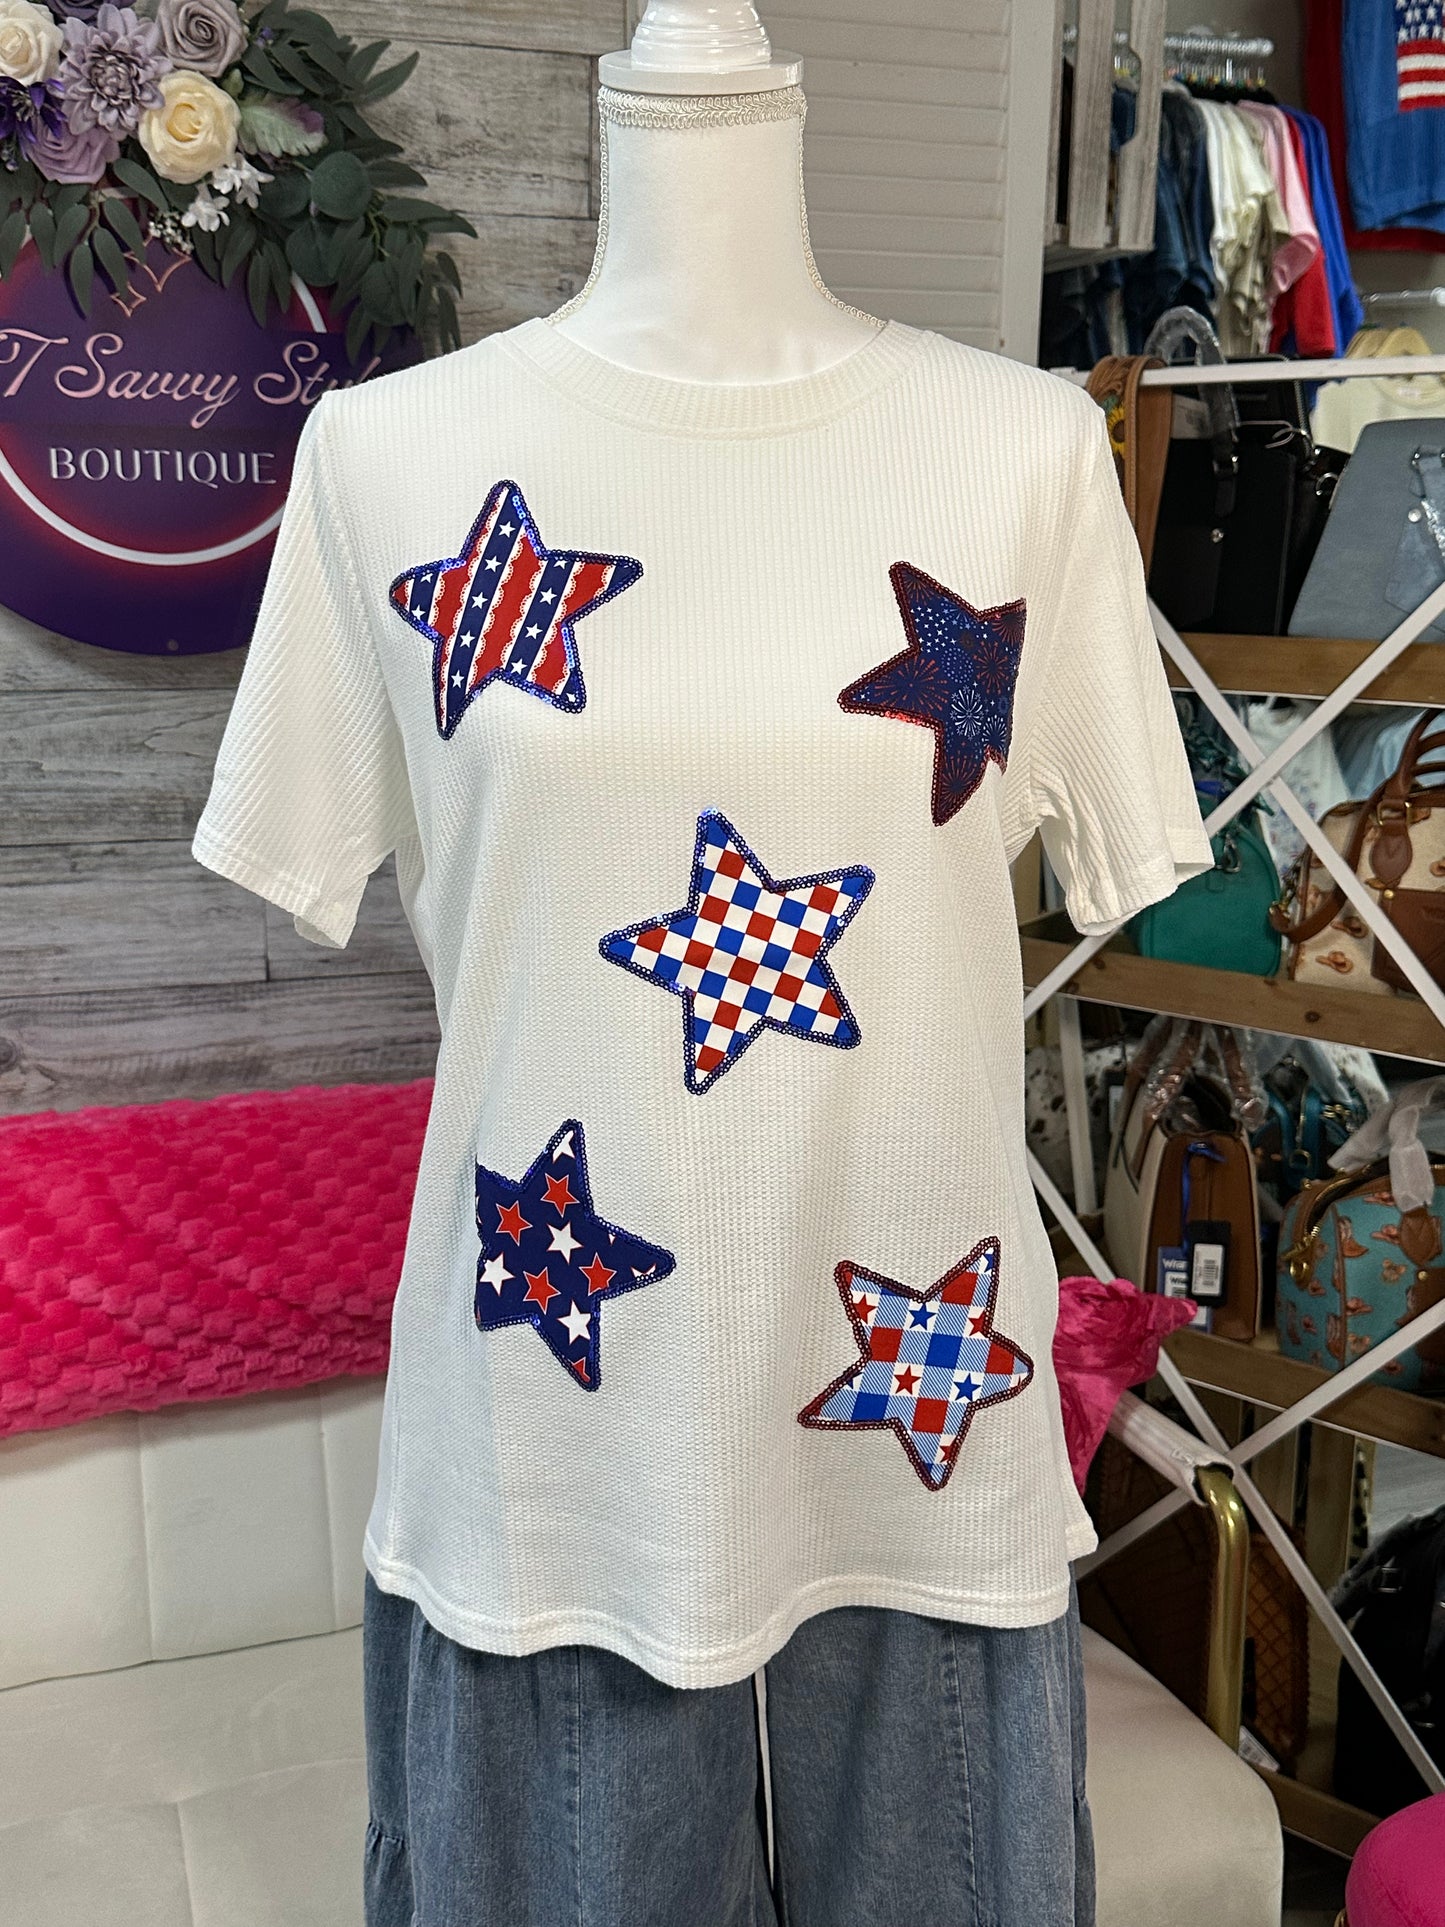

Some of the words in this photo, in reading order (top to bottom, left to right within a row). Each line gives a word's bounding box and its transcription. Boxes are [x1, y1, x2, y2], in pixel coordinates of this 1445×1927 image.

[0, 328, 69, 397] T
[54, 333, 241, 428] Savvy
[253, 341, 381, 405] Stl
[49, 447, 277, 489] BOUTIQUE
